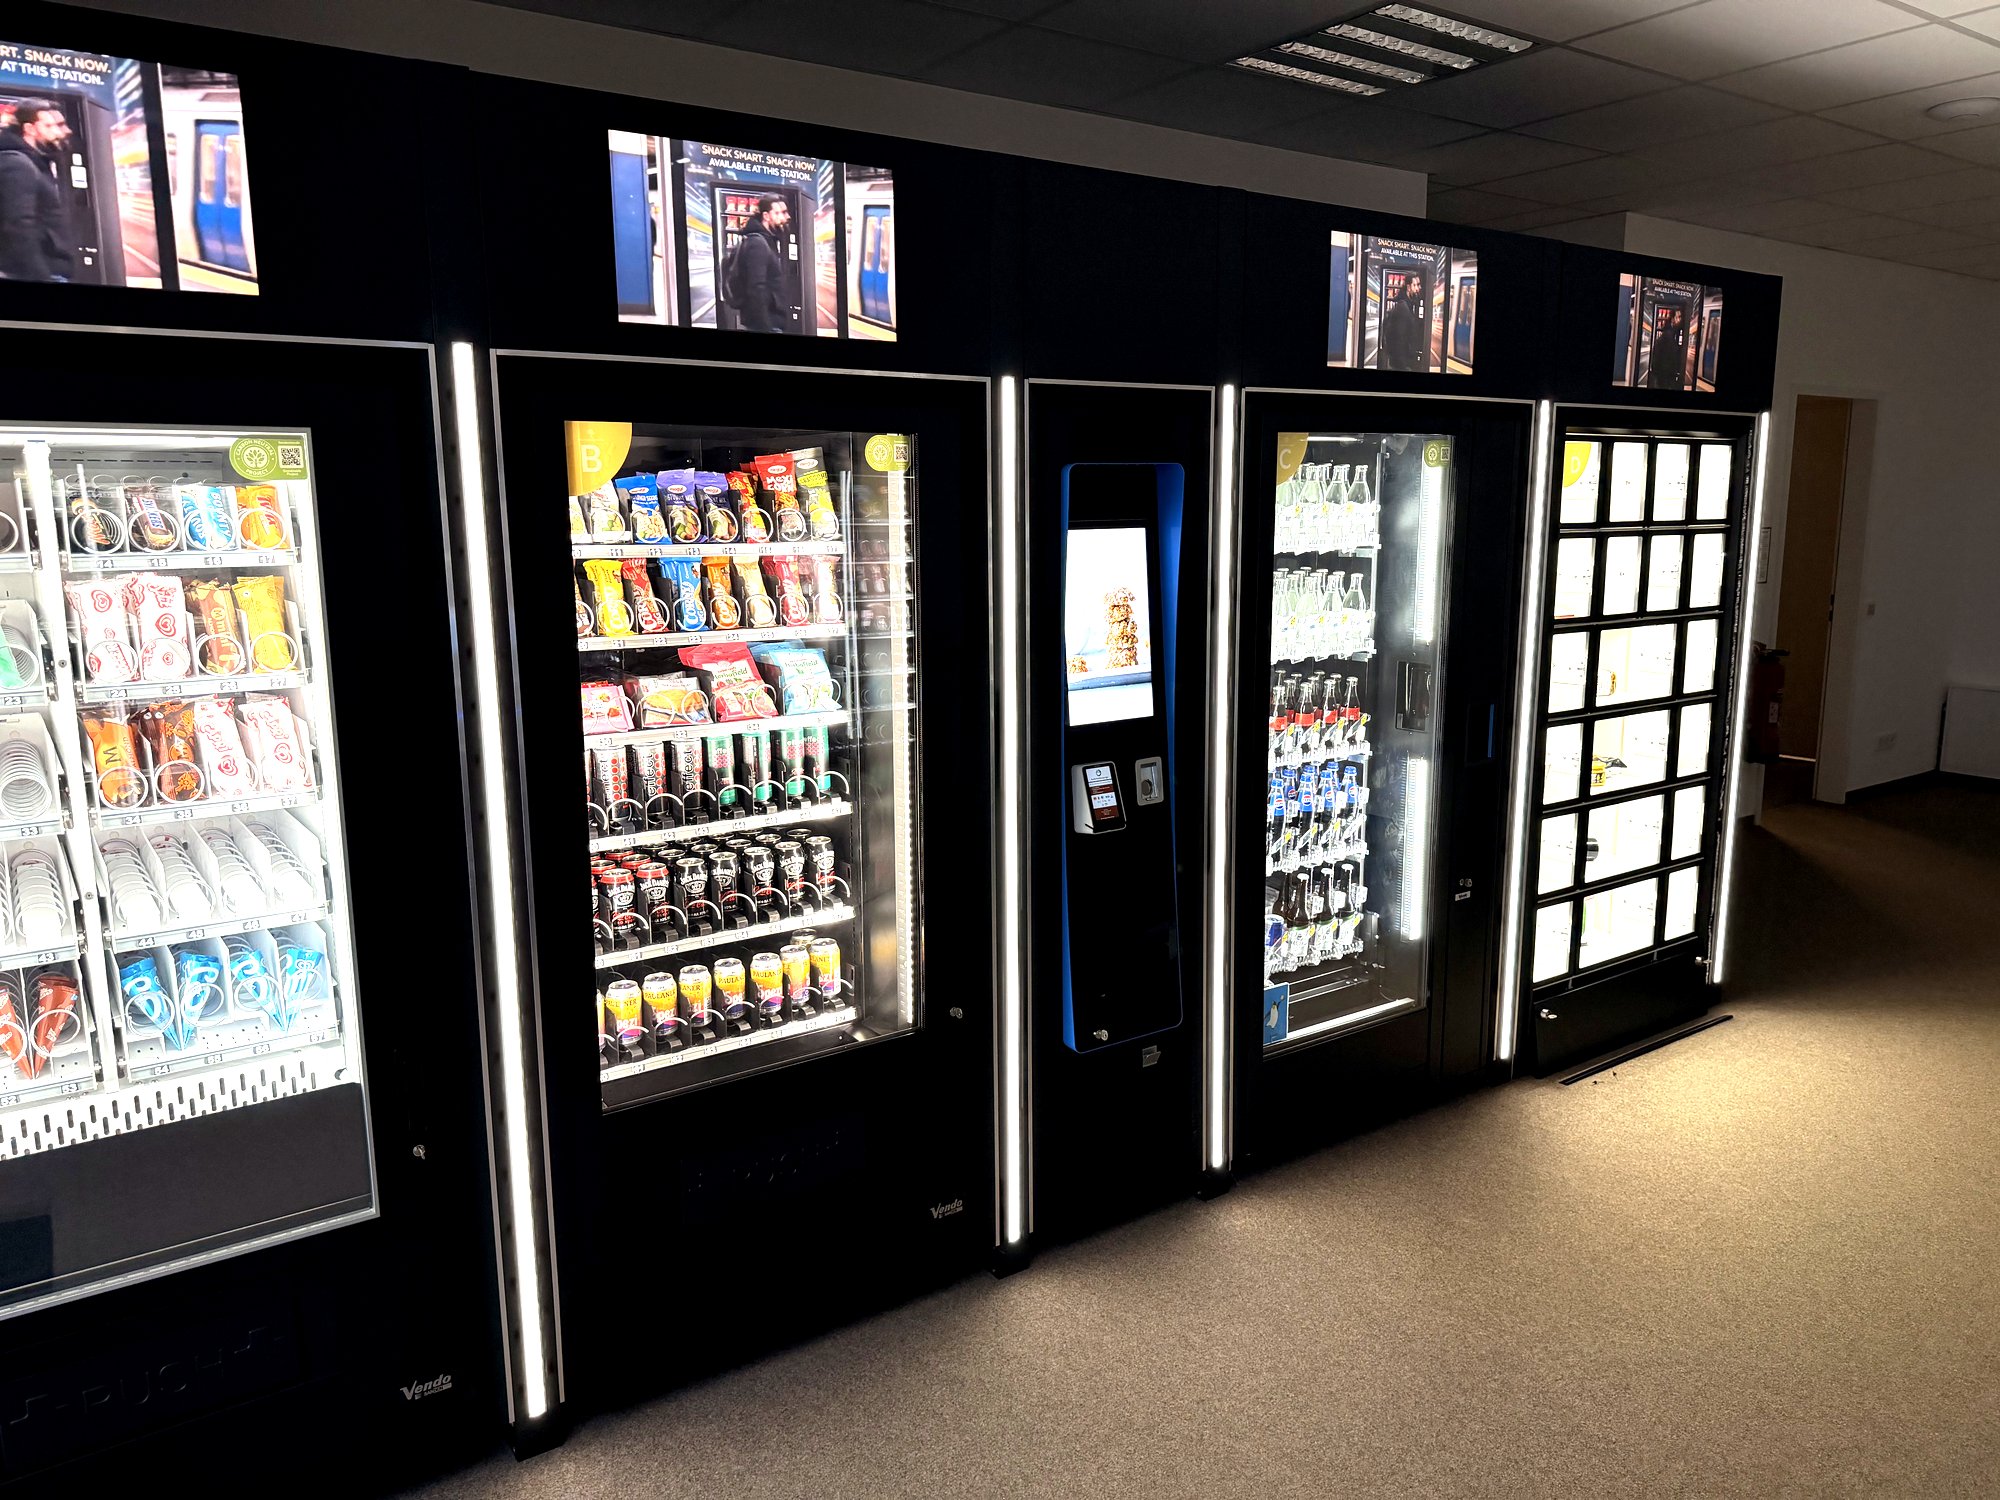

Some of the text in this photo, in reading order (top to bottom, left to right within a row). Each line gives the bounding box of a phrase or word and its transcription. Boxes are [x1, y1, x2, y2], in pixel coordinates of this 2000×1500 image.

[24, 49, 72, 67] SNACK
[74, 57, 112, 73] NOW.
[1, 60, 105, 85] AT THIS STATION.
[701, 144, 817, 172] SNACK SMART. SNACK NOW.
[709, 157, 812, 181] AVAILABLE AT THIS STATION.
[235, 439, 275, 456] CARBON NEUTRAL
[581, 444, 603, 473] B
[1279, 449, 1291, 469] C
[1570, 456, 1580, 474] D
[245, 468, 269, 477] PROJECT
[103, 746, 121, 765] M
[682, 750, 693, 792] effect
[21, 827, 40, 837] 33
[137, 937, 155, 948] 44
[38, 953, 57, 963] 43
[930, 1199, 963, 1219] Vendo
[400, 1373, 452, 1400] Vendo
